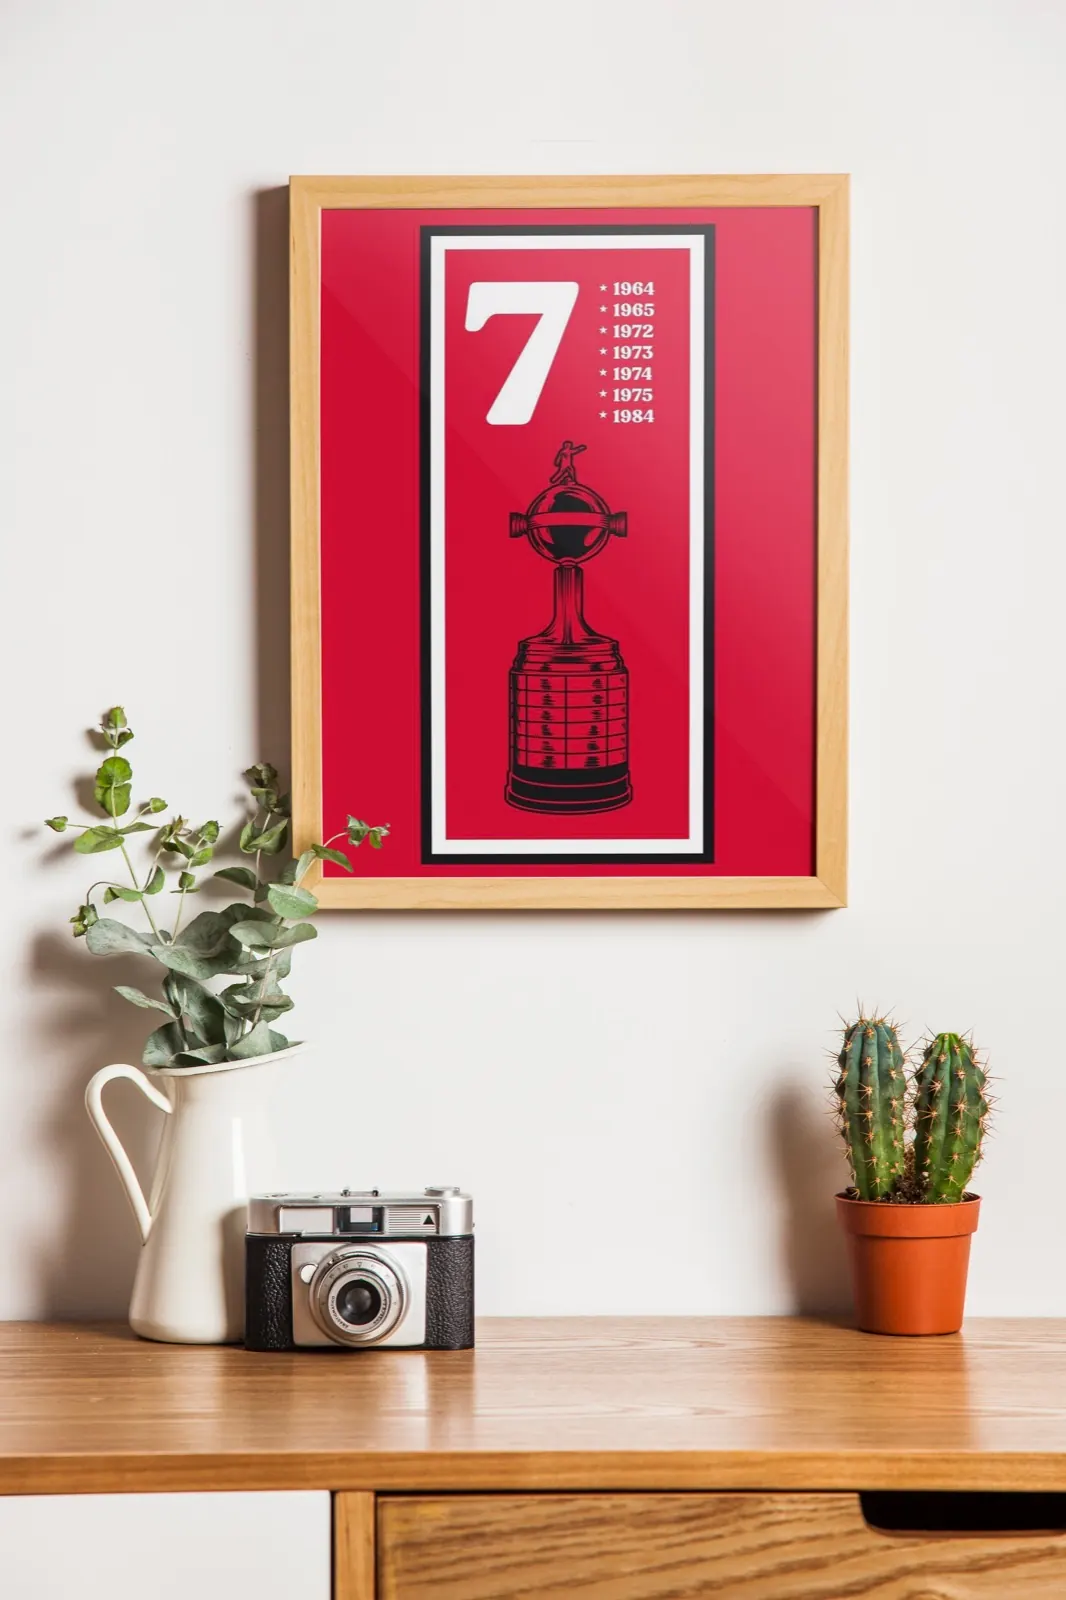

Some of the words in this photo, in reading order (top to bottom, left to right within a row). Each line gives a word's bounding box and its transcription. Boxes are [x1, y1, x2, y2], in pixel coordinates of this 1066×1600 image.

[613, 282, 655, 296] 1964
[613, 303, 655, 317] 1965
[613, 324, 654, 338] 1972
[465, 281, 579, 425] 7
[613, 346, 654, 360] 1973
[613, 367, 652, 381] 1974
[613, 388, 653, 402] 1975
[613, 409, 655, 423] 1984
